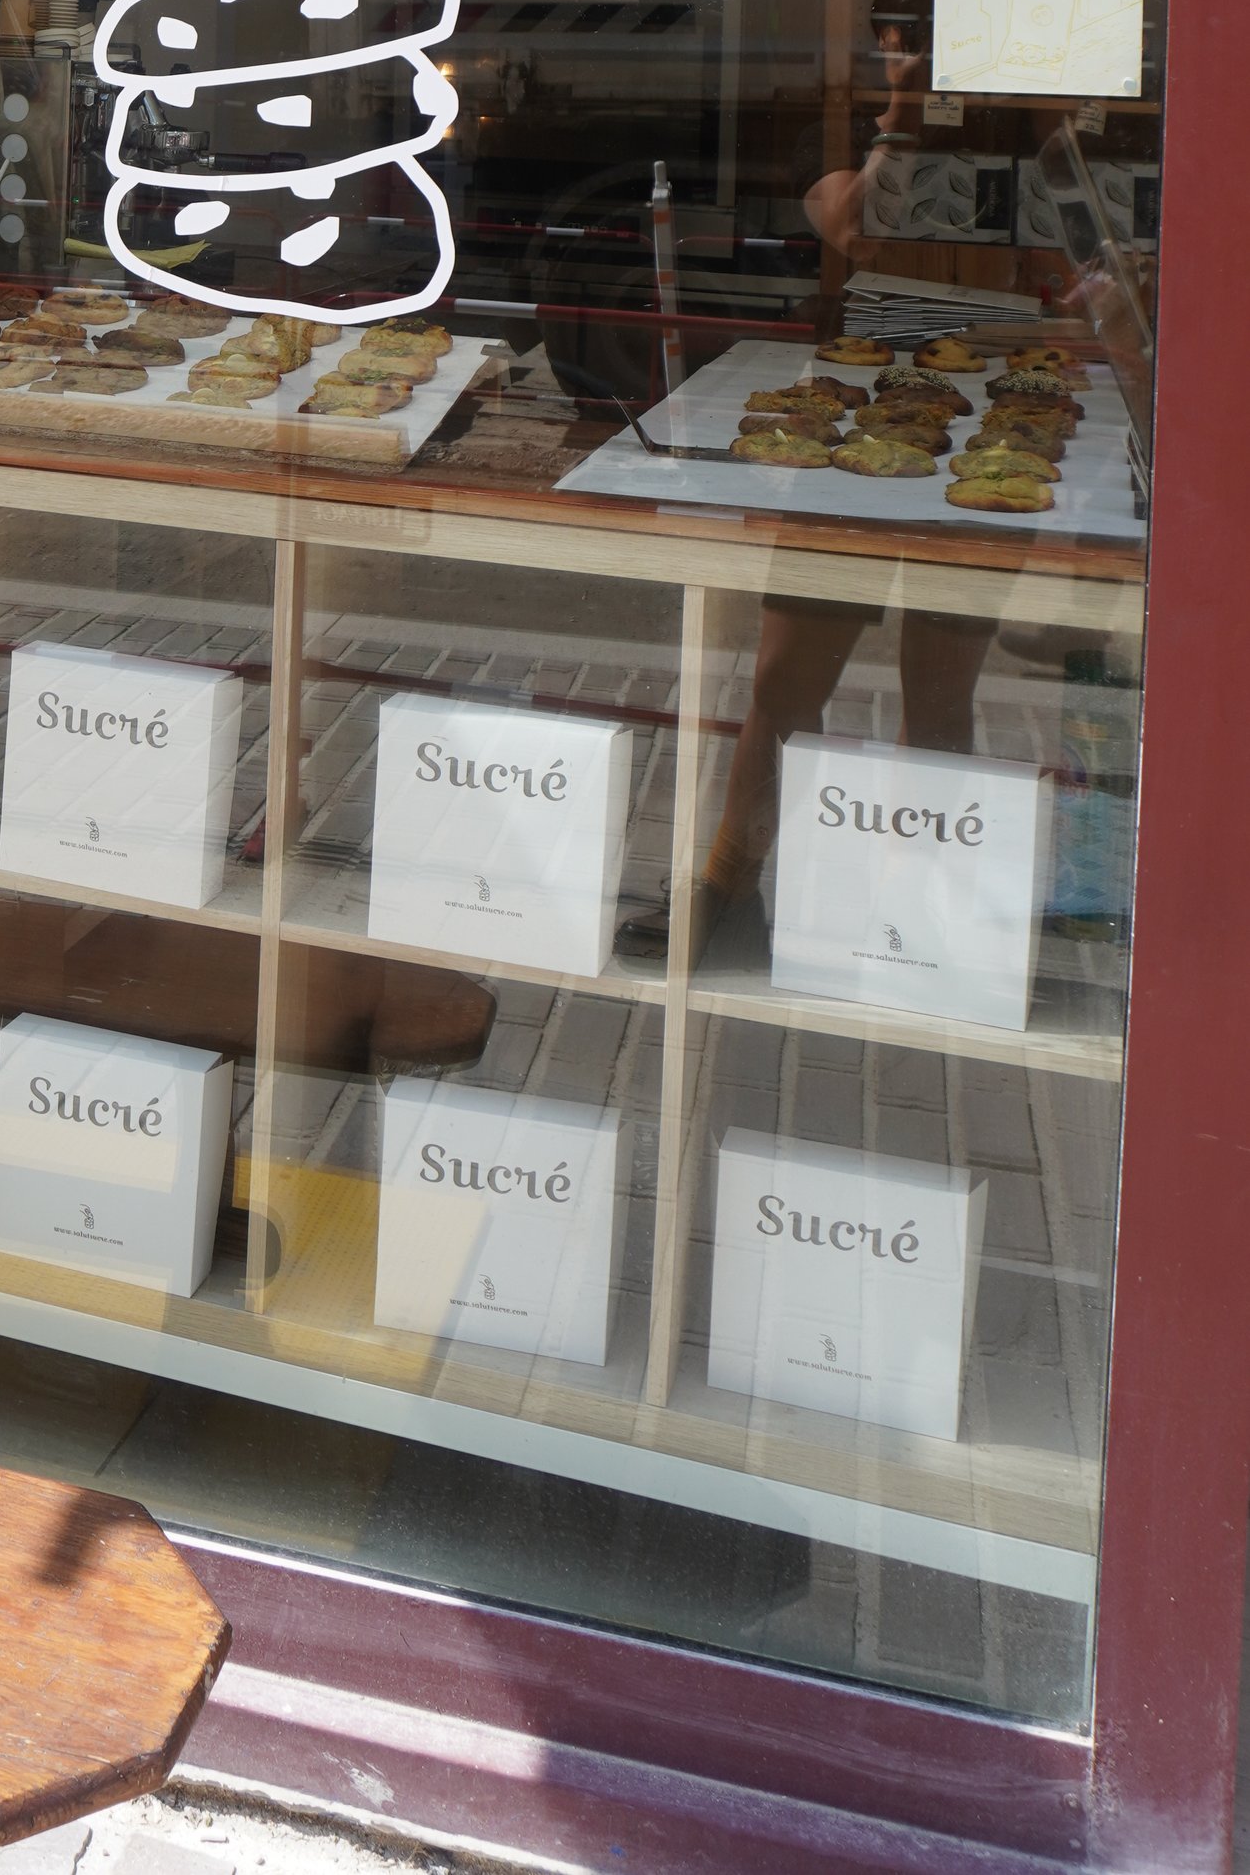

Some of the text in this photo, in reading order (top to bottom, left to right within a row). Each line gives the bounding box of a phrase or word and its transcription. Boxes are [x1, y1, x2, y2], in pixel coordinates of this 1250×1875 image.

[35, 691, 170, 751] Sucré
[415, 741, 568, 803] Sucré
[817, 784, 985, 848] Sucré
[59, 840, 128, 858] www.salutsucre.com
[444, 900, 523, 918] www.salutsucre.com
[852, 950, 938, 969] www.salutsucre.com
[28, 1075, 163, 1138] Sucré
[419, 1143, 572, 1205] Sucré
[54, 1226, 124, 1246] www.salutsucre.com
[756, 1193, 920, 1266] Sucré
[449, 1298, 528, 1317] www.salutsucre.com
[787, 1357, 872, 1381] www.salutsucre.com
